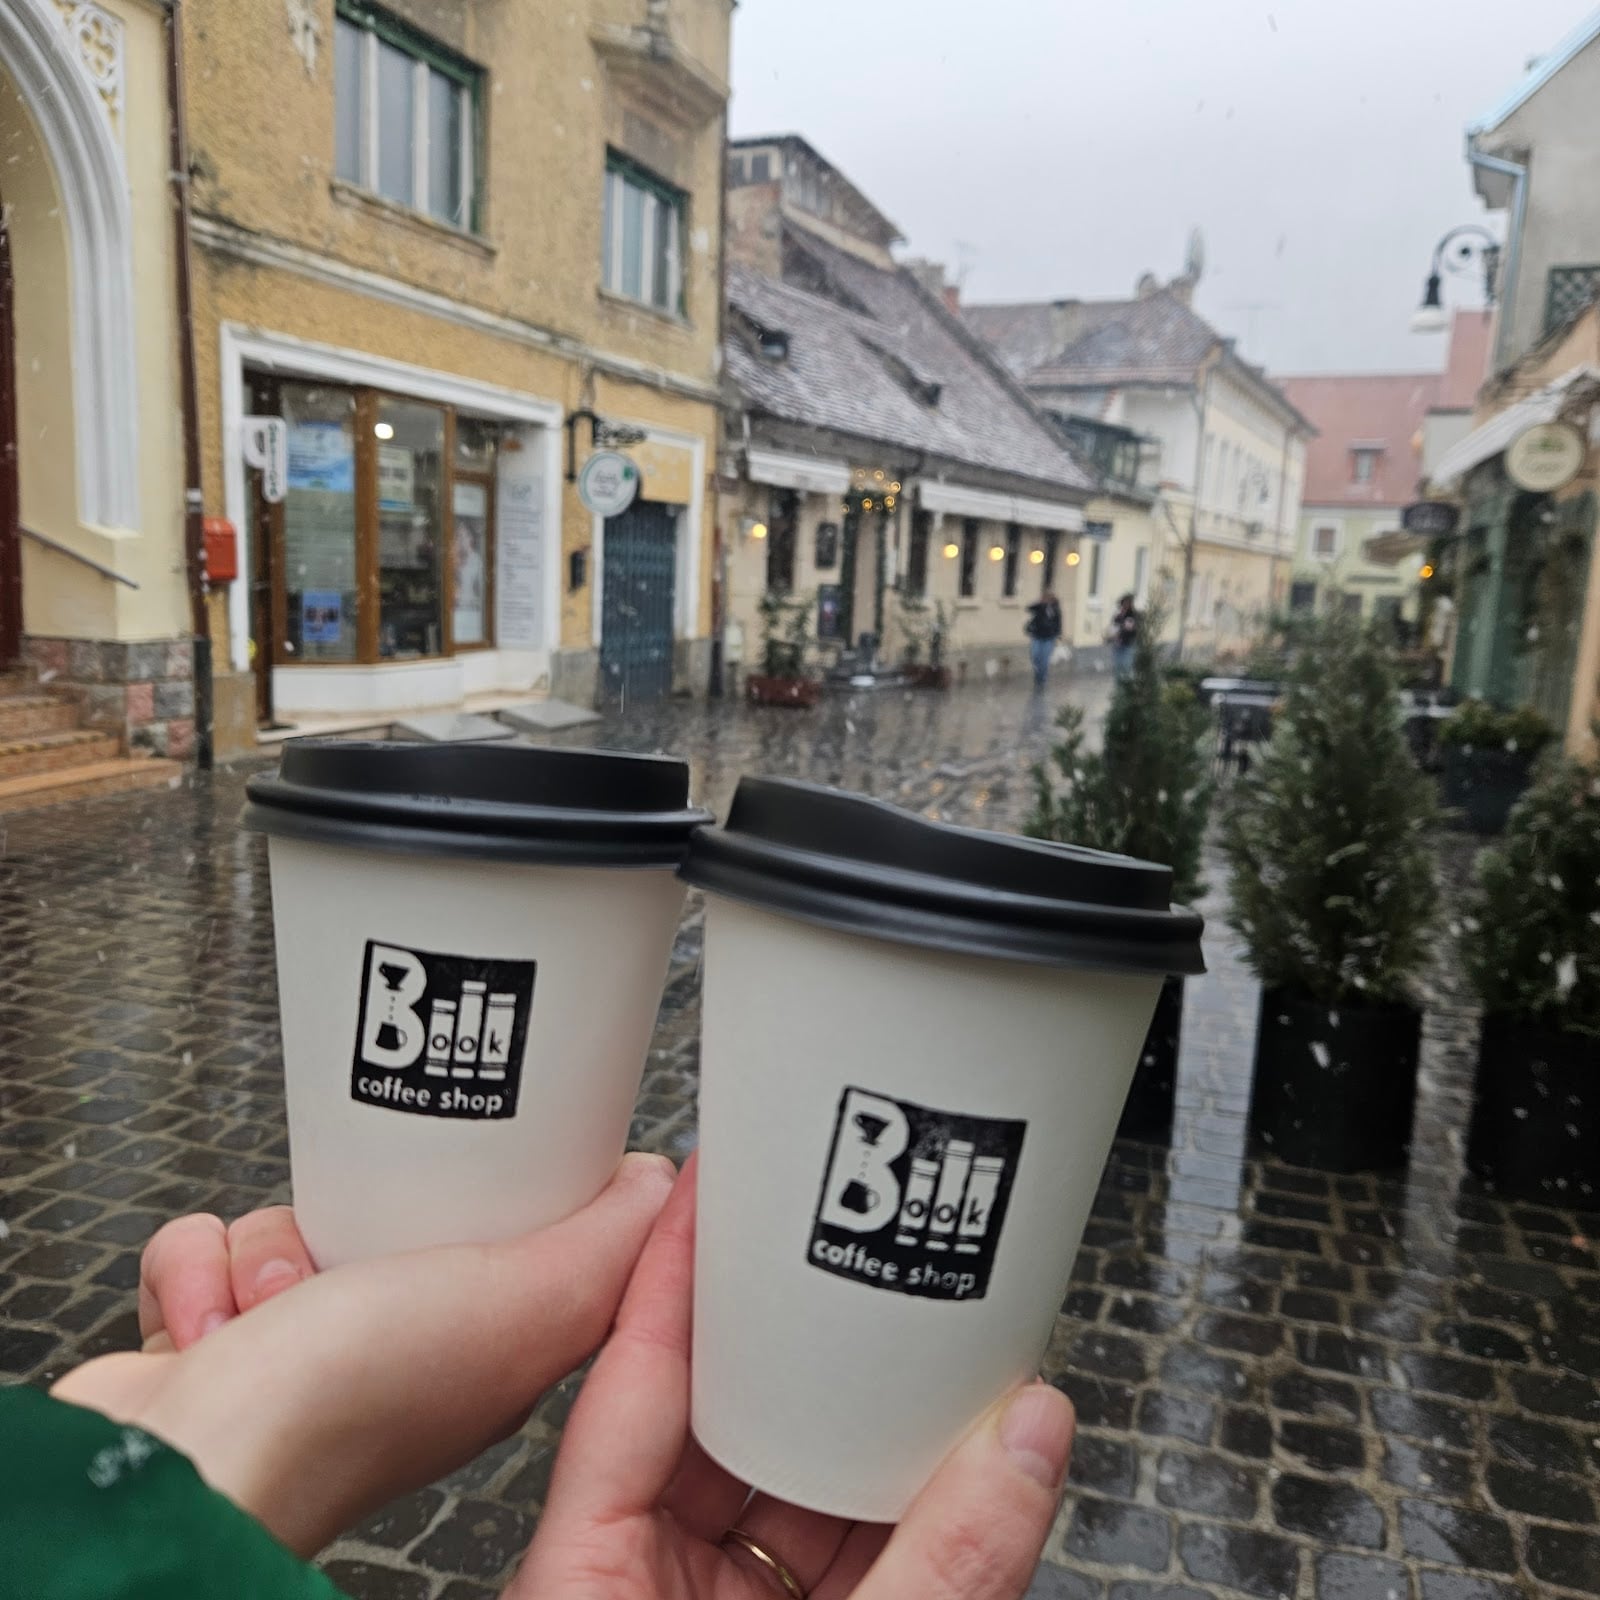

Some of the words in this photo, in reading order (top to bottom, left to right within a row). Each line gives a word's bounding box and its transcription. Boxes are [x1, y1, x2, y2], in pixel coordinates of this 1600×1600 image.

[361, 943, 509, 1070] Book
[358, 1076, 431, 1107] coffee
[439, 1087, 503, 1116] shop
[820, 1090, 988, 1234] Book
[813, 1240, 899, 1282] coffee
[907, 1263, 976, 1297] shop
